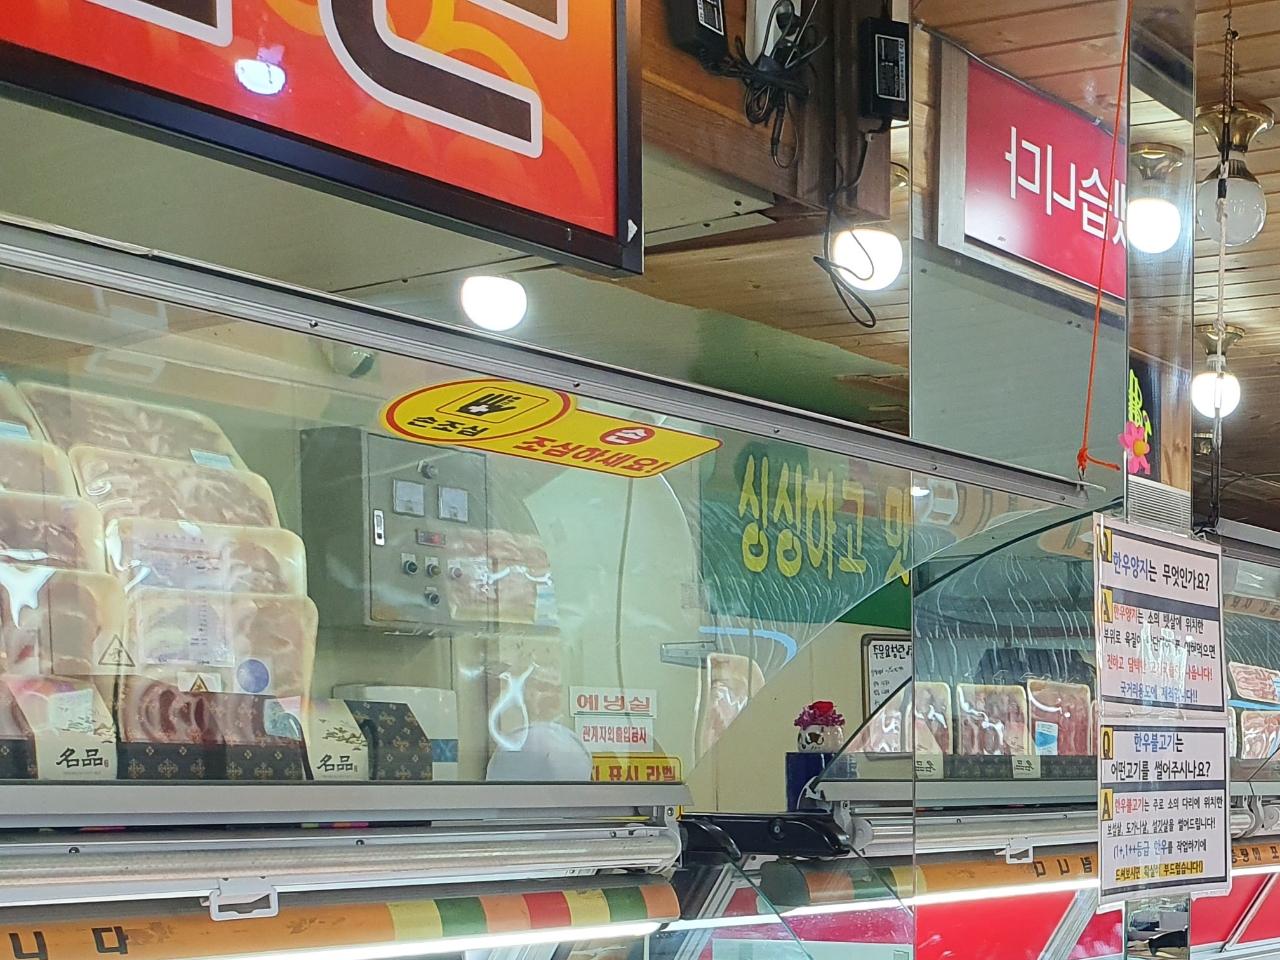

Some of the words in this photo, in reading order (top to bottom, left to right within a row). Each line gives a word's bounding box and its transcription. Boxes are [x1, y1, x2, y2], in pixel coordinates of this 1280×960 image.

[407, 414, 489, 438] 손조심
[513, 435, 670, 473] 조심하세요!
[1113, 551, 1157, 582] 한우양지는
[1162, 564, 1210, 591] 무엇인가요?
[1148, 609, 1160, 626] 소의
[1185, 618, 1204, 634] 위치한
[1104, 628, 1121, 644] 부위로
[582, 726, 647, 744] 관계자외출입금지
[1134, 733, 1184, 753] 한우불고기는
[54, 747, 104, 768] 名品
[317, 754, 354, 771] 名品
[1111, 760, 1149, 781] 어떤고기를
[1154, 760, 1211, 781] 썰어주시나요?
[1103, 792, 1111, 819] A
[1115, 797, 1150, 814] 한우불고기는
[1153, 798, 1164, 811] 주로
[1168, 797, 1179, 810] 소의
[1182, 796, 1200, 809] 다리에
[1204, 796, 1222, 809] 위치한
